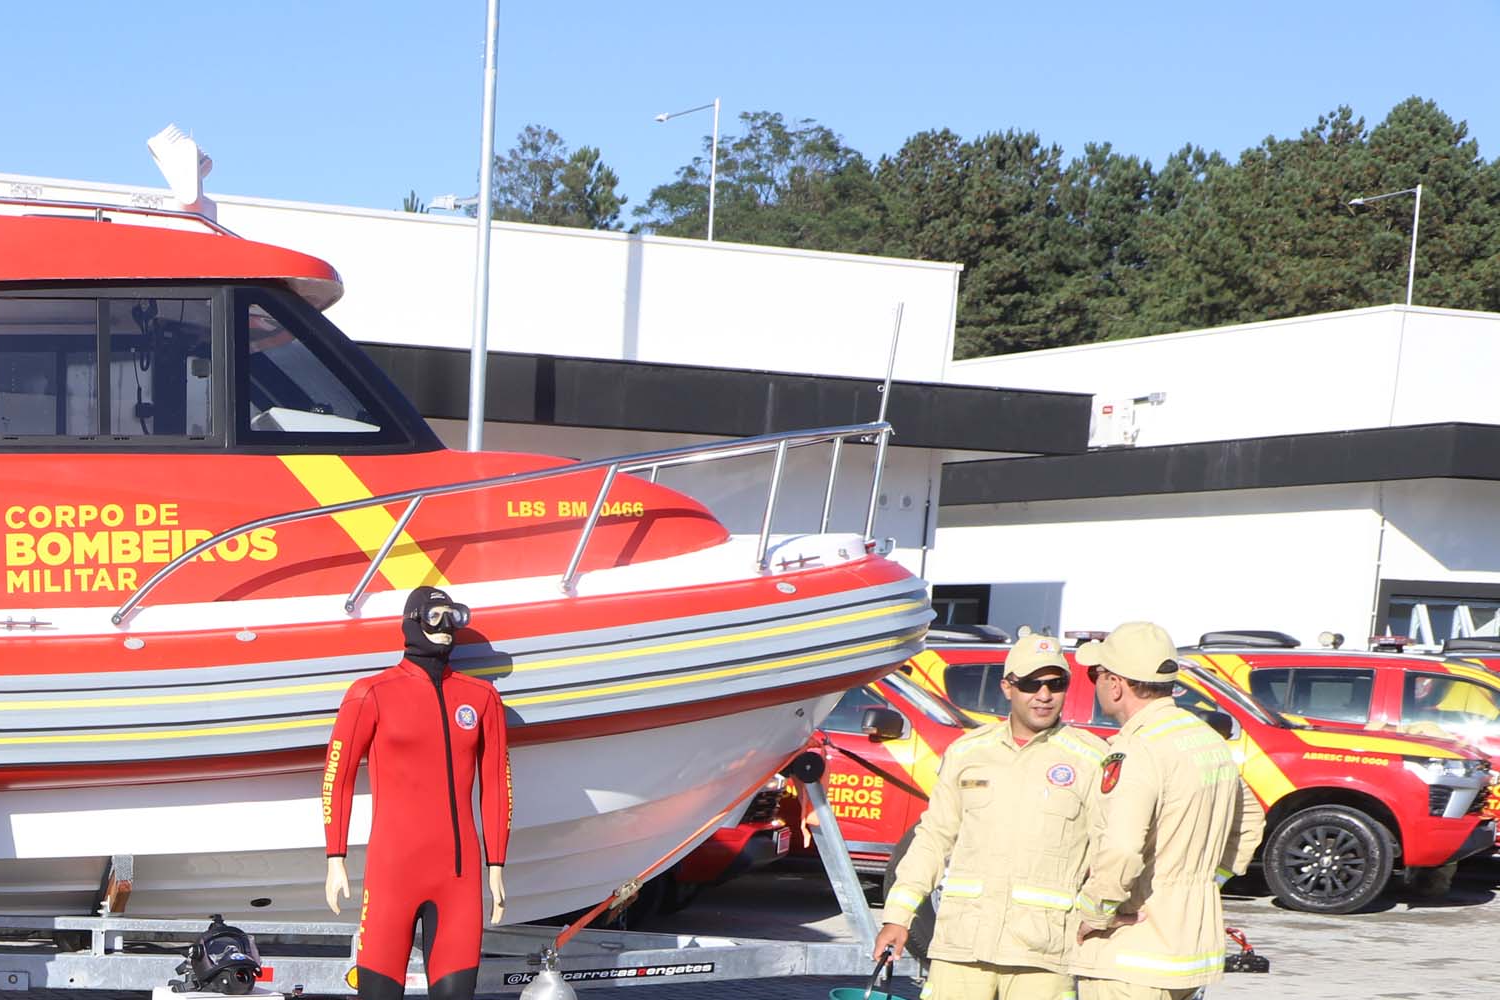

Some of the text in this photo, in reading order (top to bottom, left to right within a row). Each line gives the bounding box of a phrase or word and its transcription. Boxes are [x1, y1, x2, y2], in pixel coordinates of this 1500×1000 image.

[5, 503, 179, 529] CORPO DE
[507, 500, 644, 517] LBS BM 0466
[5, 527, 279, 567] BOMBEIROS
[6, 567, 138, 593] MILITAR
[322, 738, 343, 825] BOMBEIROS
[829, 774, 885, 788] RPO DE
[828, 788, 883, 805] EIROS
